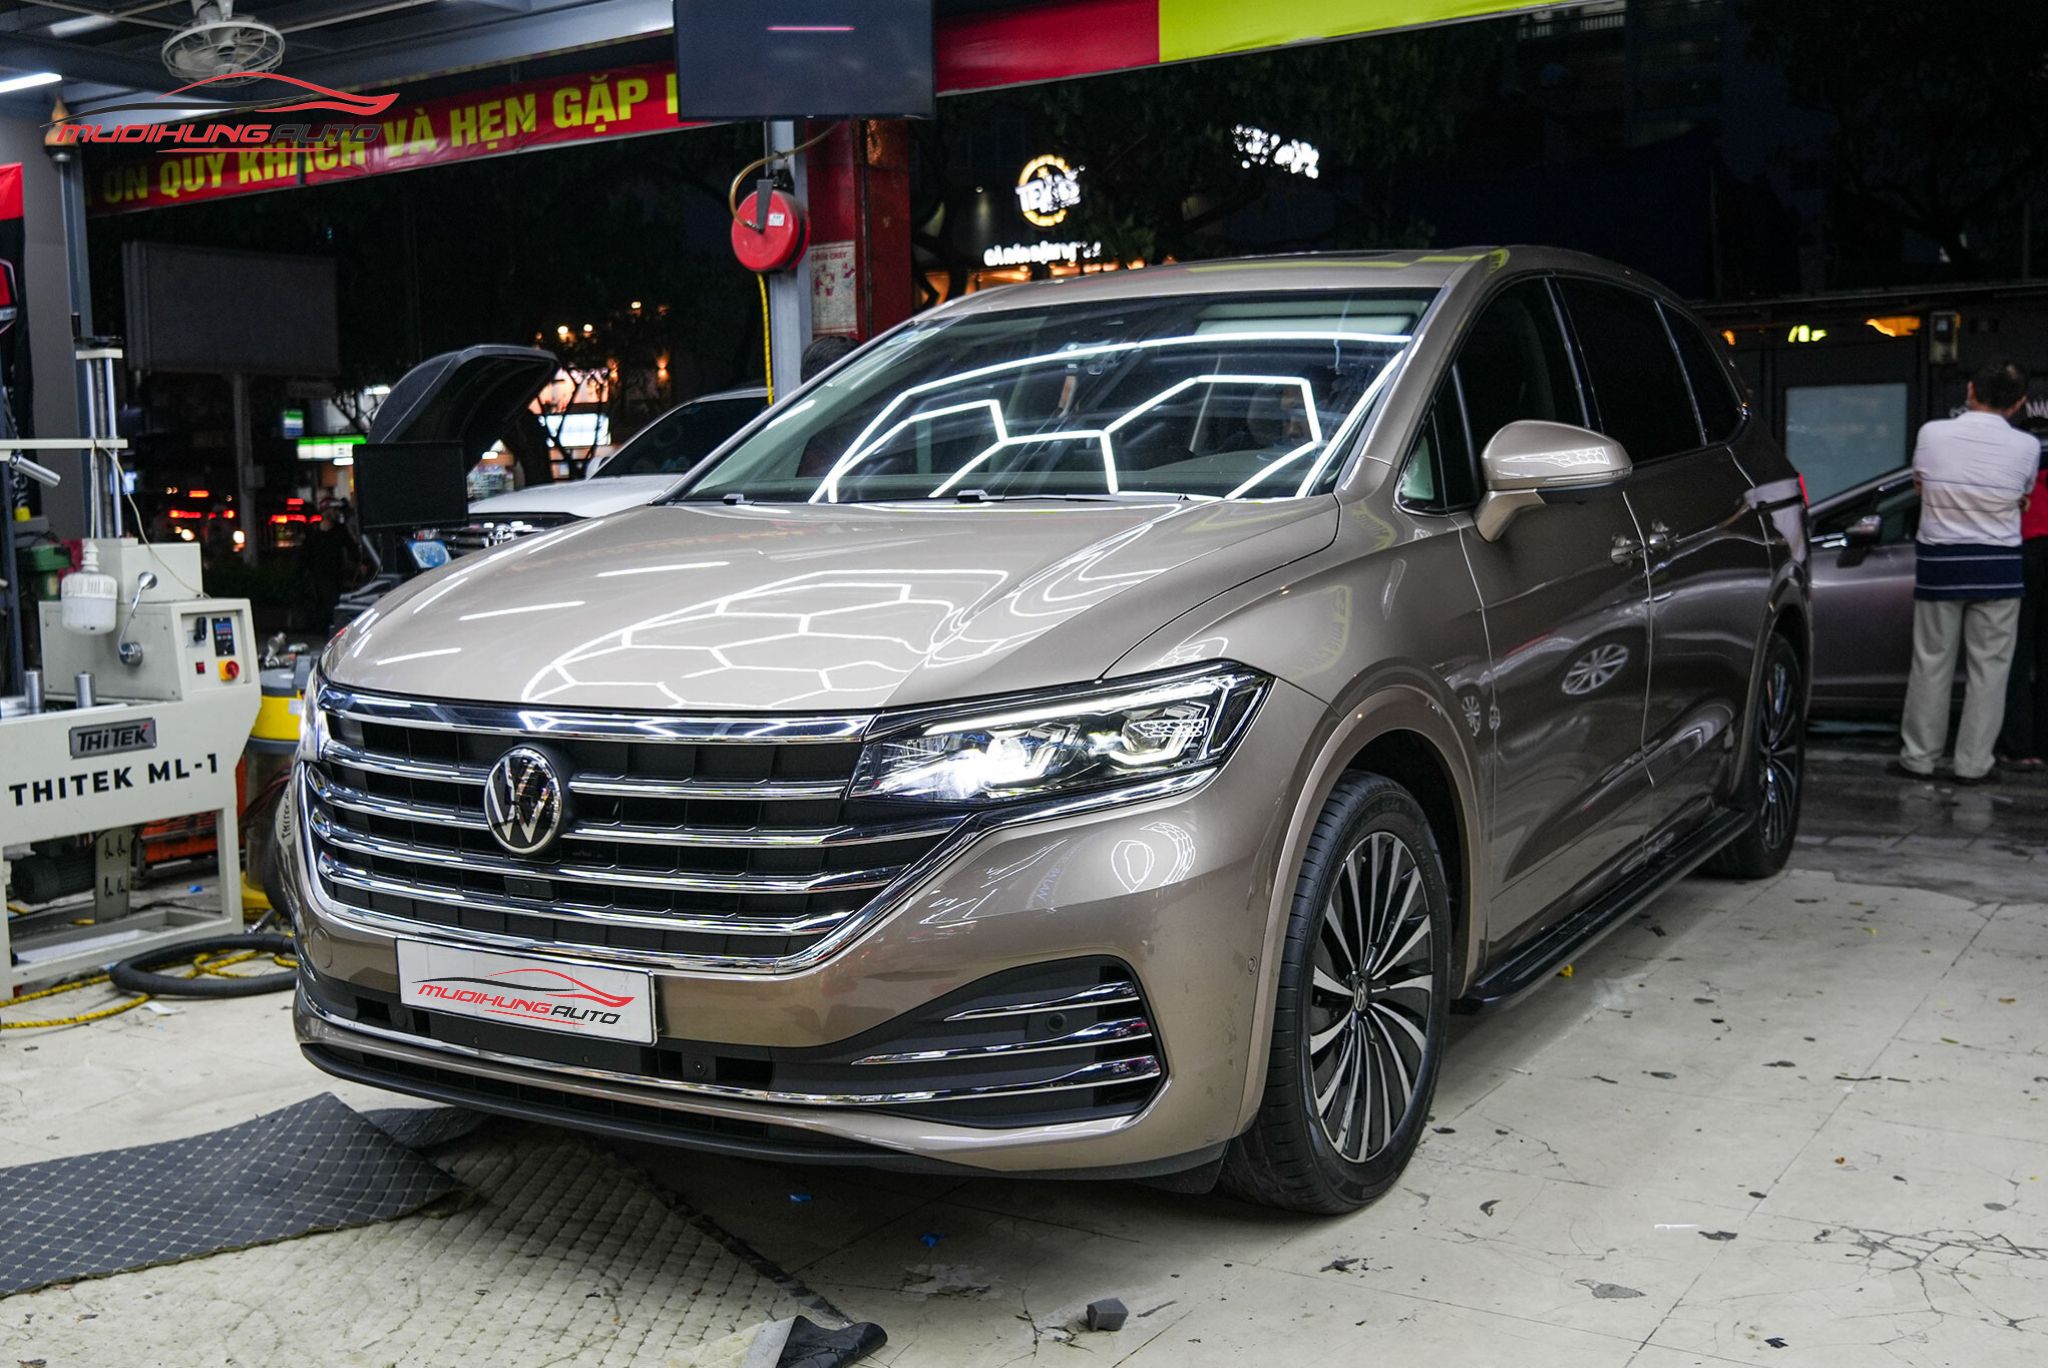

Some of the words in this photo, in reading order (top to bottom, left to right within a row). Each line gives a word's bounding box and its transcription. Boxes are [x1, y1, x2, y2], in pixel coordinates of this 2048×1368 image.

[384, 108, 437, 157] VÀ
[450, 94, 537, 149] HẸN
[553, 74, 648, 133] GẶP
[9, 767, 133, 806] THITEK
[148, 753, 218, 783] ML-1
